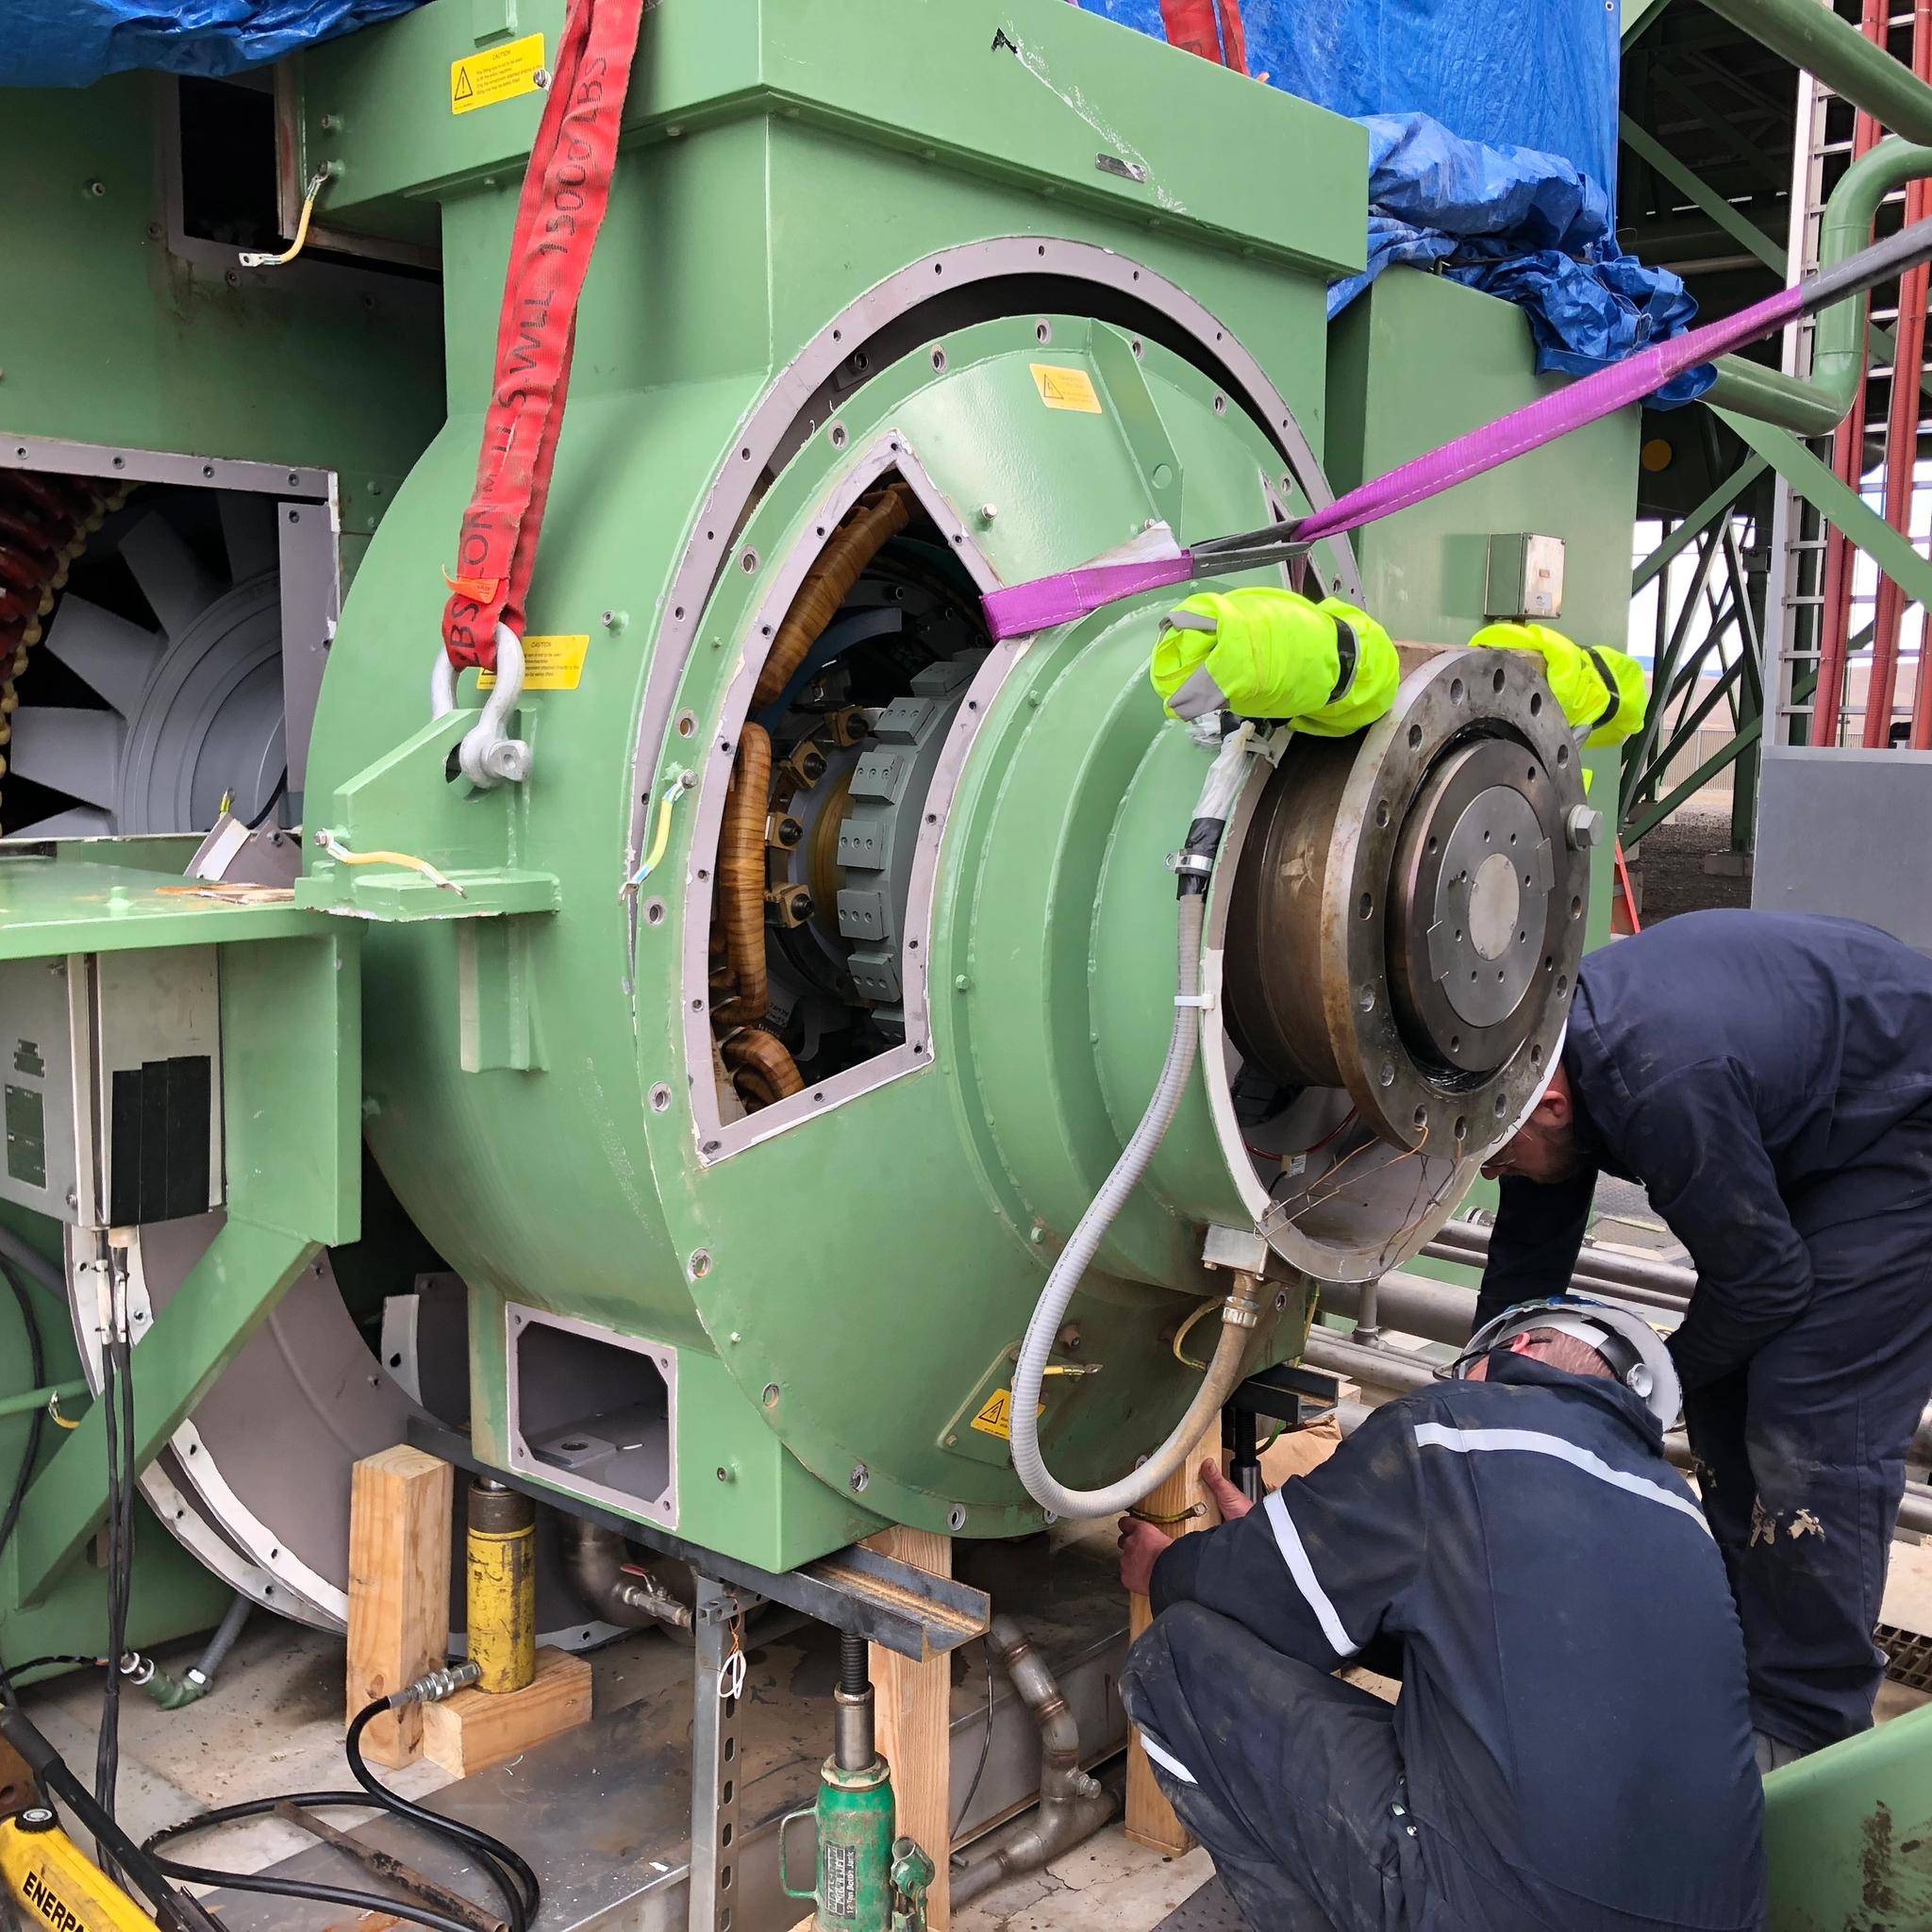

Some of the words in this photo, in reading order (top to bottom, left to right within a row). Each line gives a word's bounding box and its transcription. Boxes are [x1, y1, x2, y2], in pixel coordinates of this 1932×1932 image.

[509, 289, 556, 375] WLL
[537, 138, 592, 256] 15000
[568, 57, 607, 123] LBS
